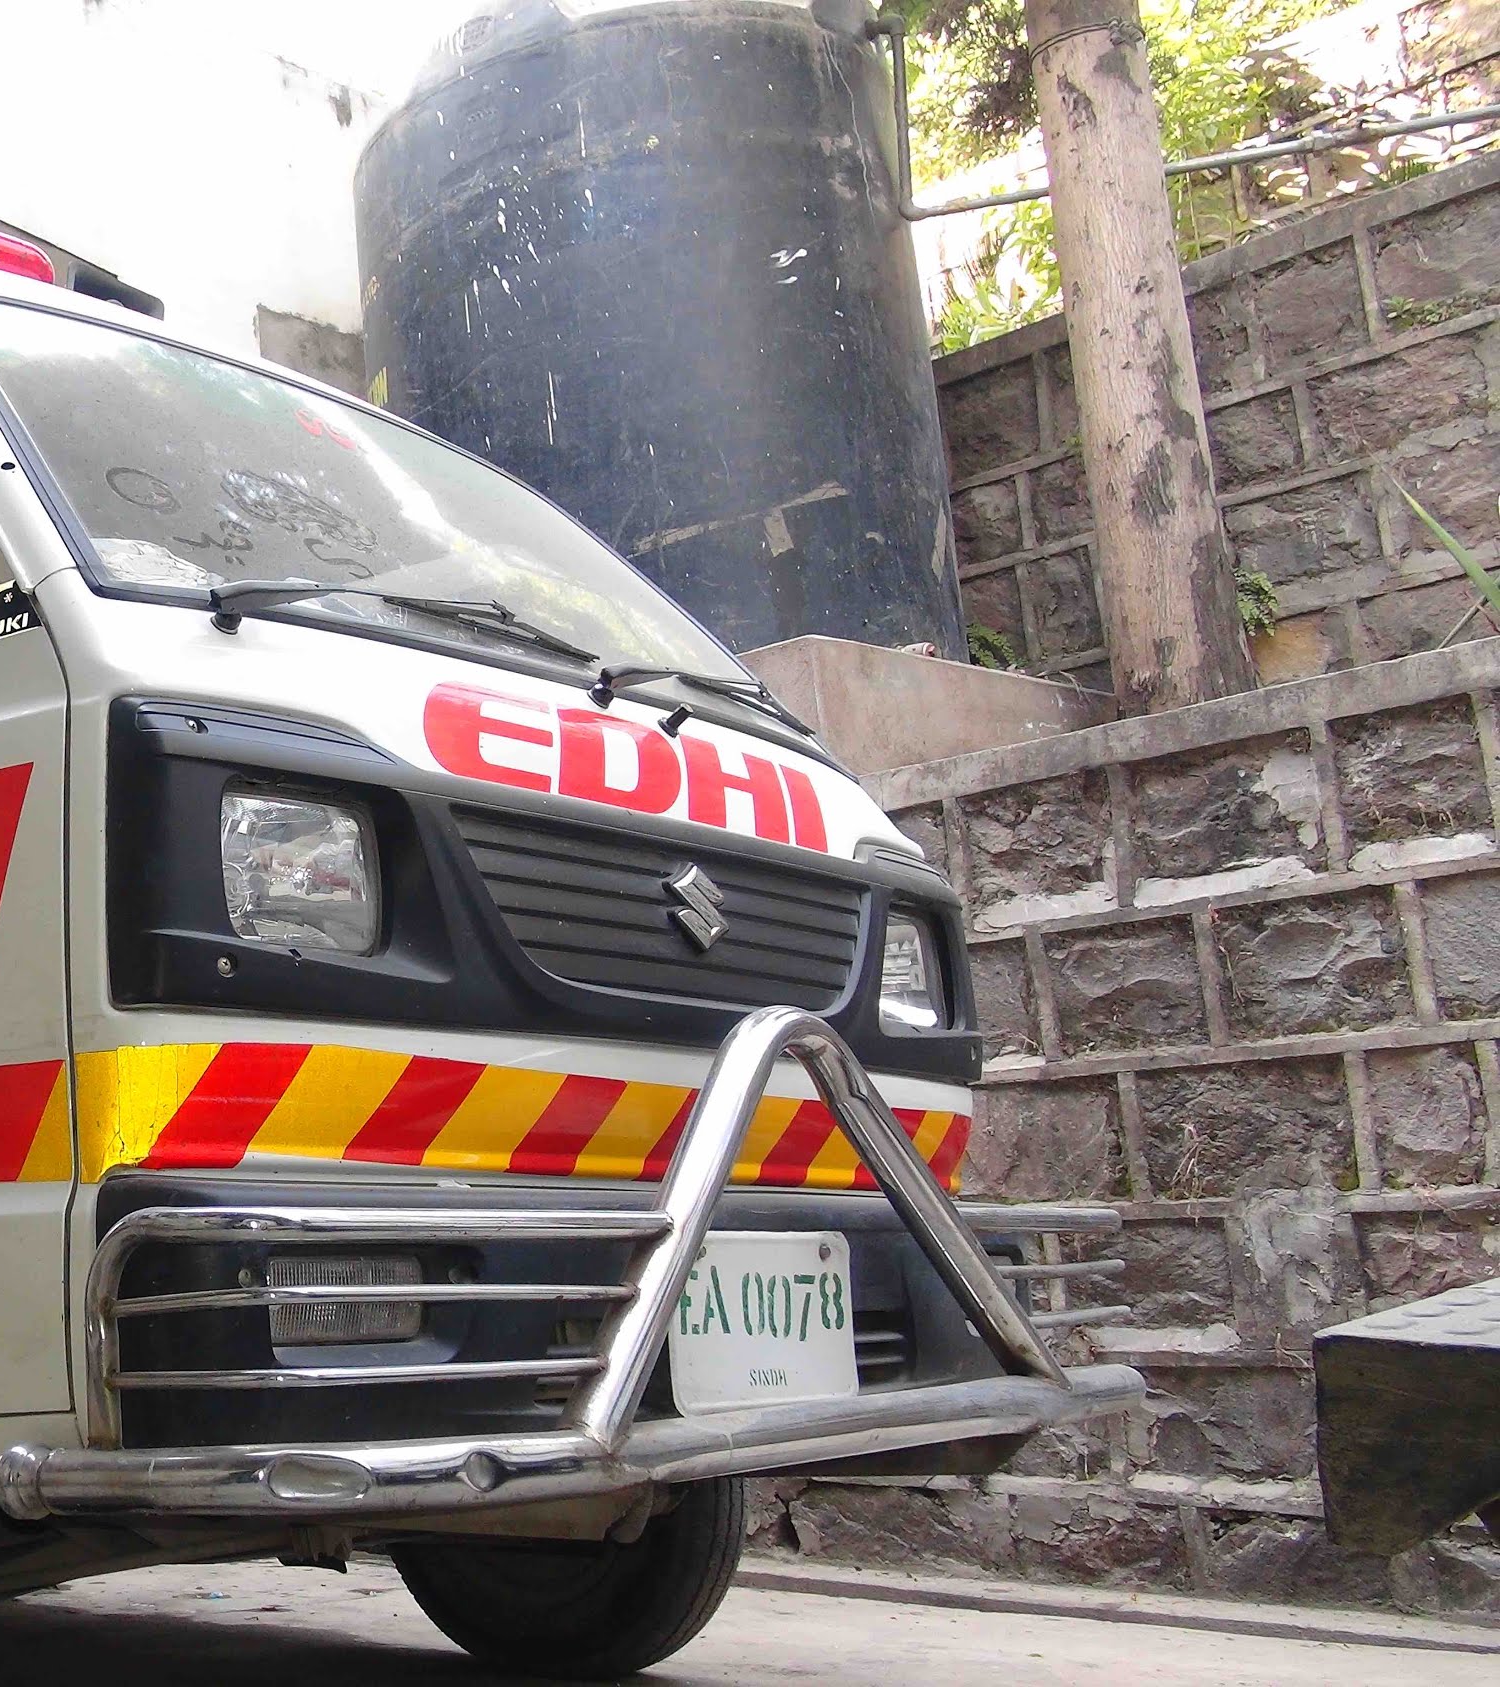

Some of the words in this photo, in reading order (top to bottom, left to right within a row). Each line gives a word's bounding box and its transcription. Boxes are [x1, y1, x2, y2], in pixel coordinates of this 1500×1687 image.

[424, 681, 829, 853] EDHI
[741, 1271, 845, 1342] 0078
[749, 1368, 788, 1387] SINDH
